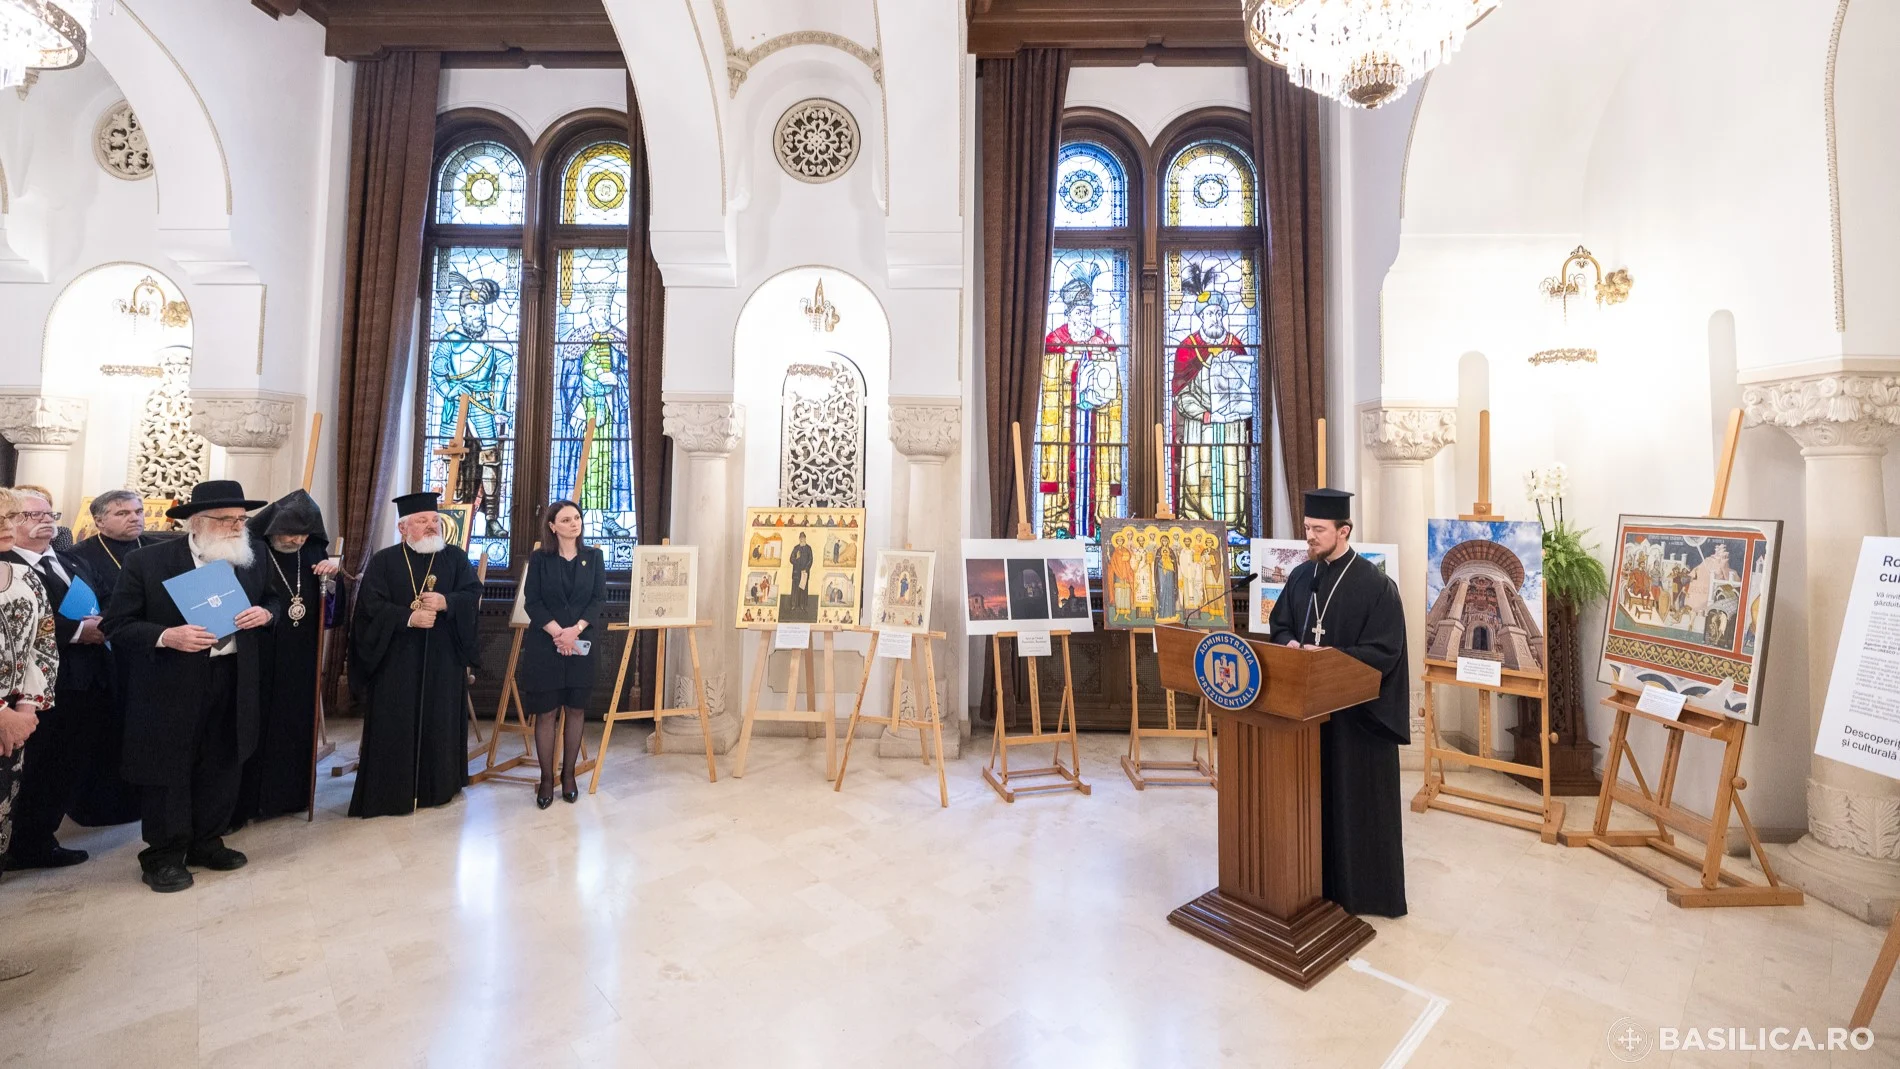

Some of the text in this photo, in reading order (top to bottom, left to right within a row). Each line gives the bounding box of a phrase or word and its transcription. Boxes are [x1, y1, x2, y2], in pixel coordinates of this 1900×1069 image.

[1873, 600, 1900, 608] găzduit
[1841, 738, 1897, 760] și culturală
